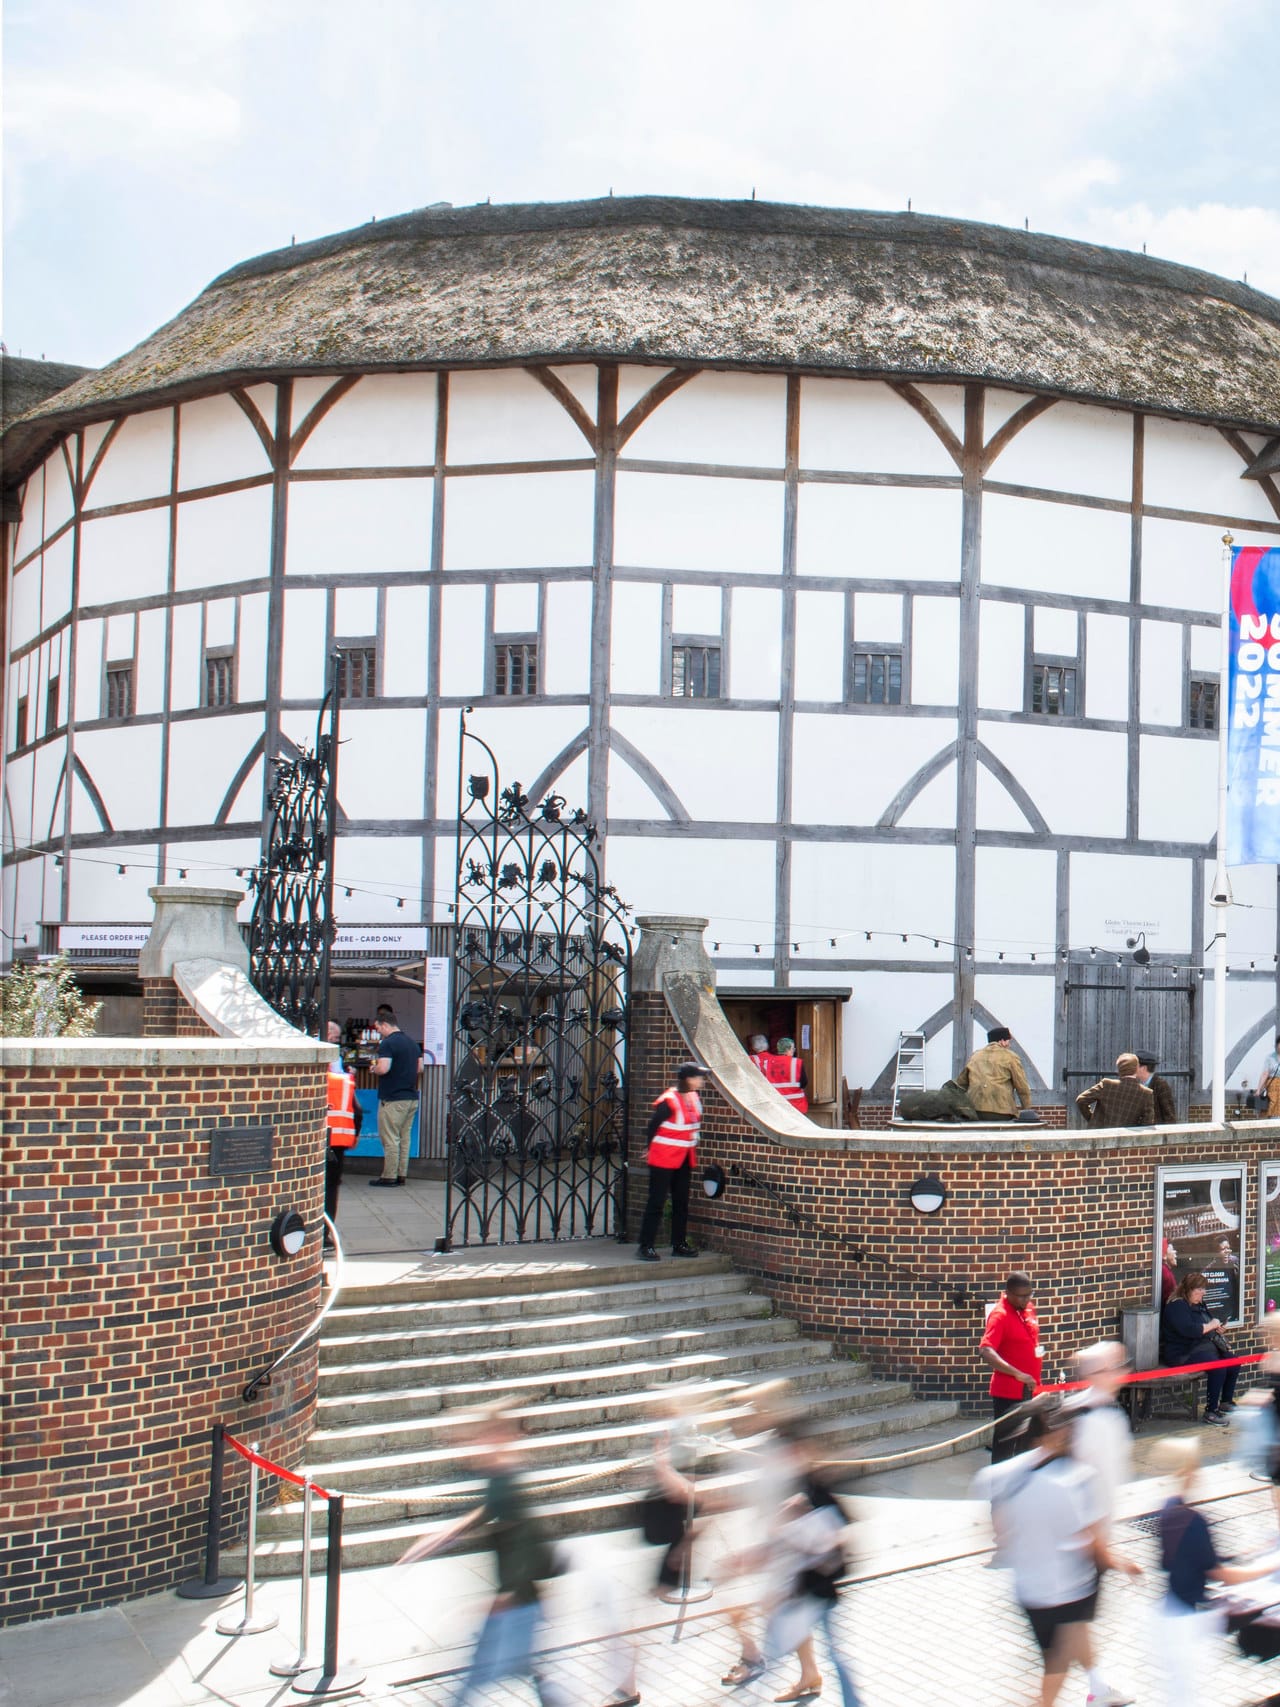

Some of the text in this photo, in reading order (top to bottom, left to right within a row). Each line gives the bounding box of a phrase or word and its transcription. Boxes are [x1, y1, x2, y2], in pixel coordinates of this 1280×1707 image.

[1233, 613, 1267, 729] 2022
[360, 935, 381, 943] CARD
[382, 935, 402, 943] ONLY
